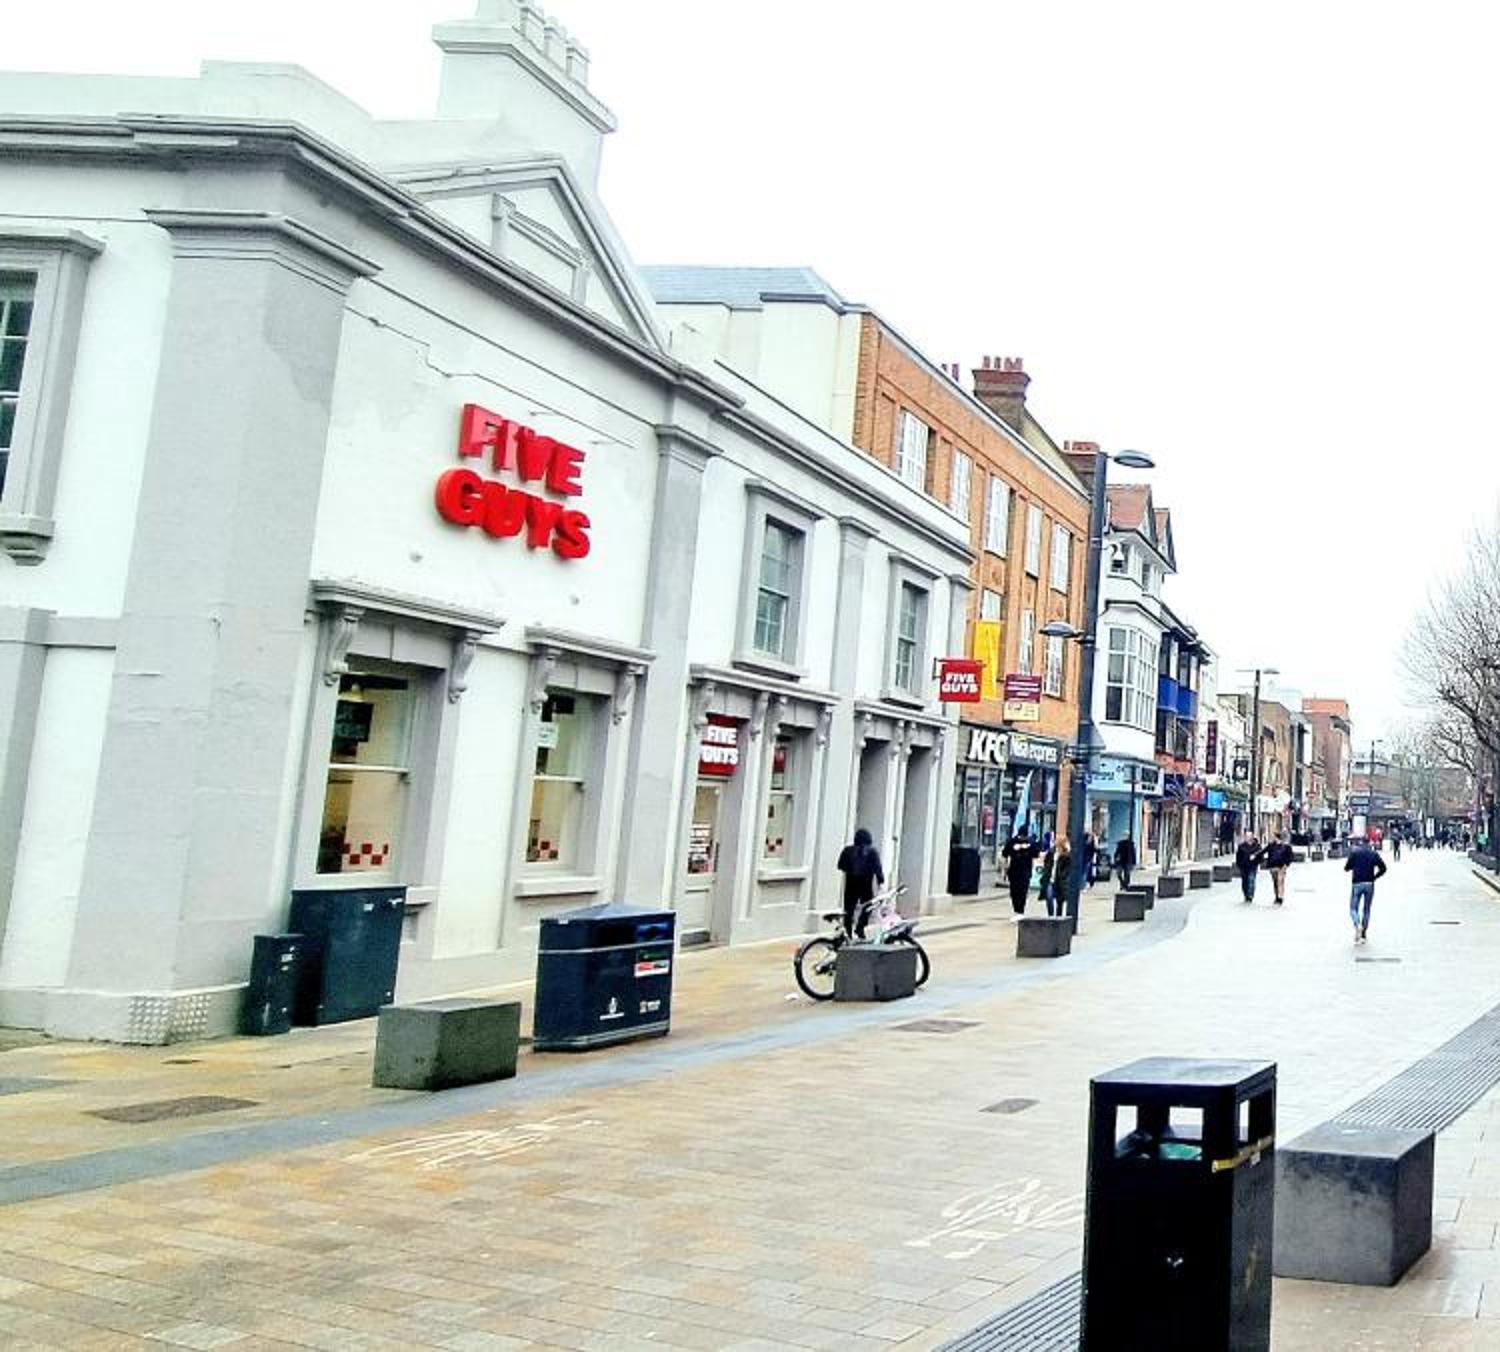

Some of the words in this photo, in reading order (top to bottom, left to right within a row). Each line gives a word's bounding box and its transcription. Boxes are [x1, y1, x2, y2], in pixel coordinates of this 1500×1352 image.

[459, 403, 586, 496] FIVE
[435, 469, 590, 558] GUYS
[941, 683, 978, 693] GUYS
[945, 673, 975, 684] FIVE
[707, 726, 738, 744] FIVE
[968, 728, 1009, 765] KFC
